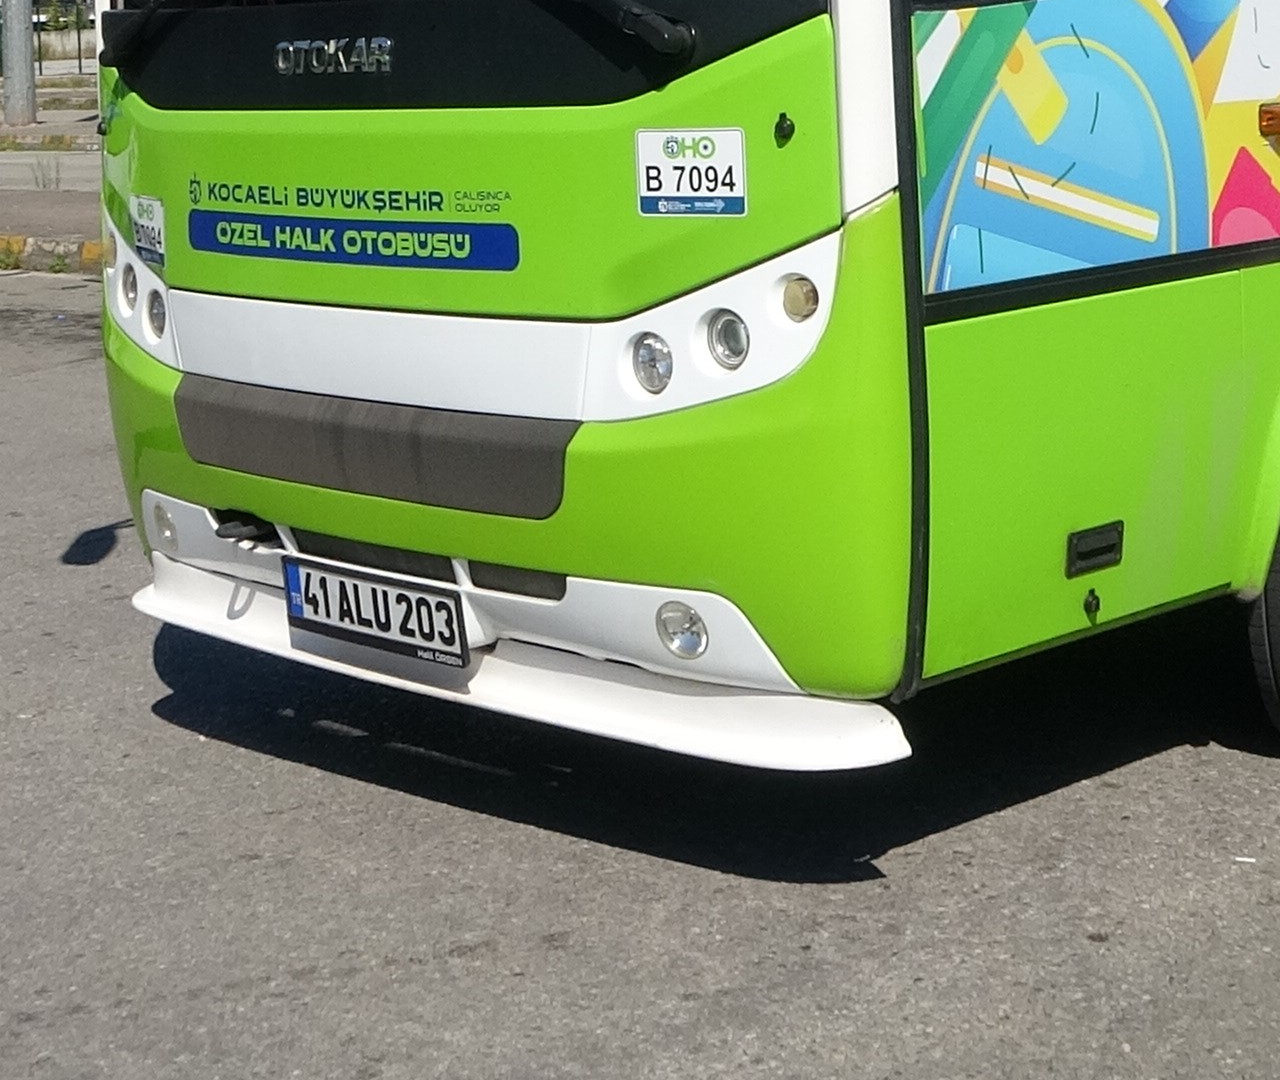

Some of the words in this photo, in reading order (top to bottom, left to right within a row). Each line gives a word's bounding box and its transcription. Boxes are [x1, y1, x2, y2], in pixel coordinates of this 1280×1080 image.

[273, 37, 393, 75] OTOKAR
[646, 165, 663, 193] B
[671, 164, 737, 193] 7094
[455, 203, 501, 213] OLUYOR
[216, 221, 270, 248] ÖZEL
[275, 226, 336, 253] HALK
[343, 231, 471, 259] OTOBÜSÜ
[303, 572, 331, 618] 41
[338, 580, 392, 633] ALU
[395, 592, 457, 647] 203
